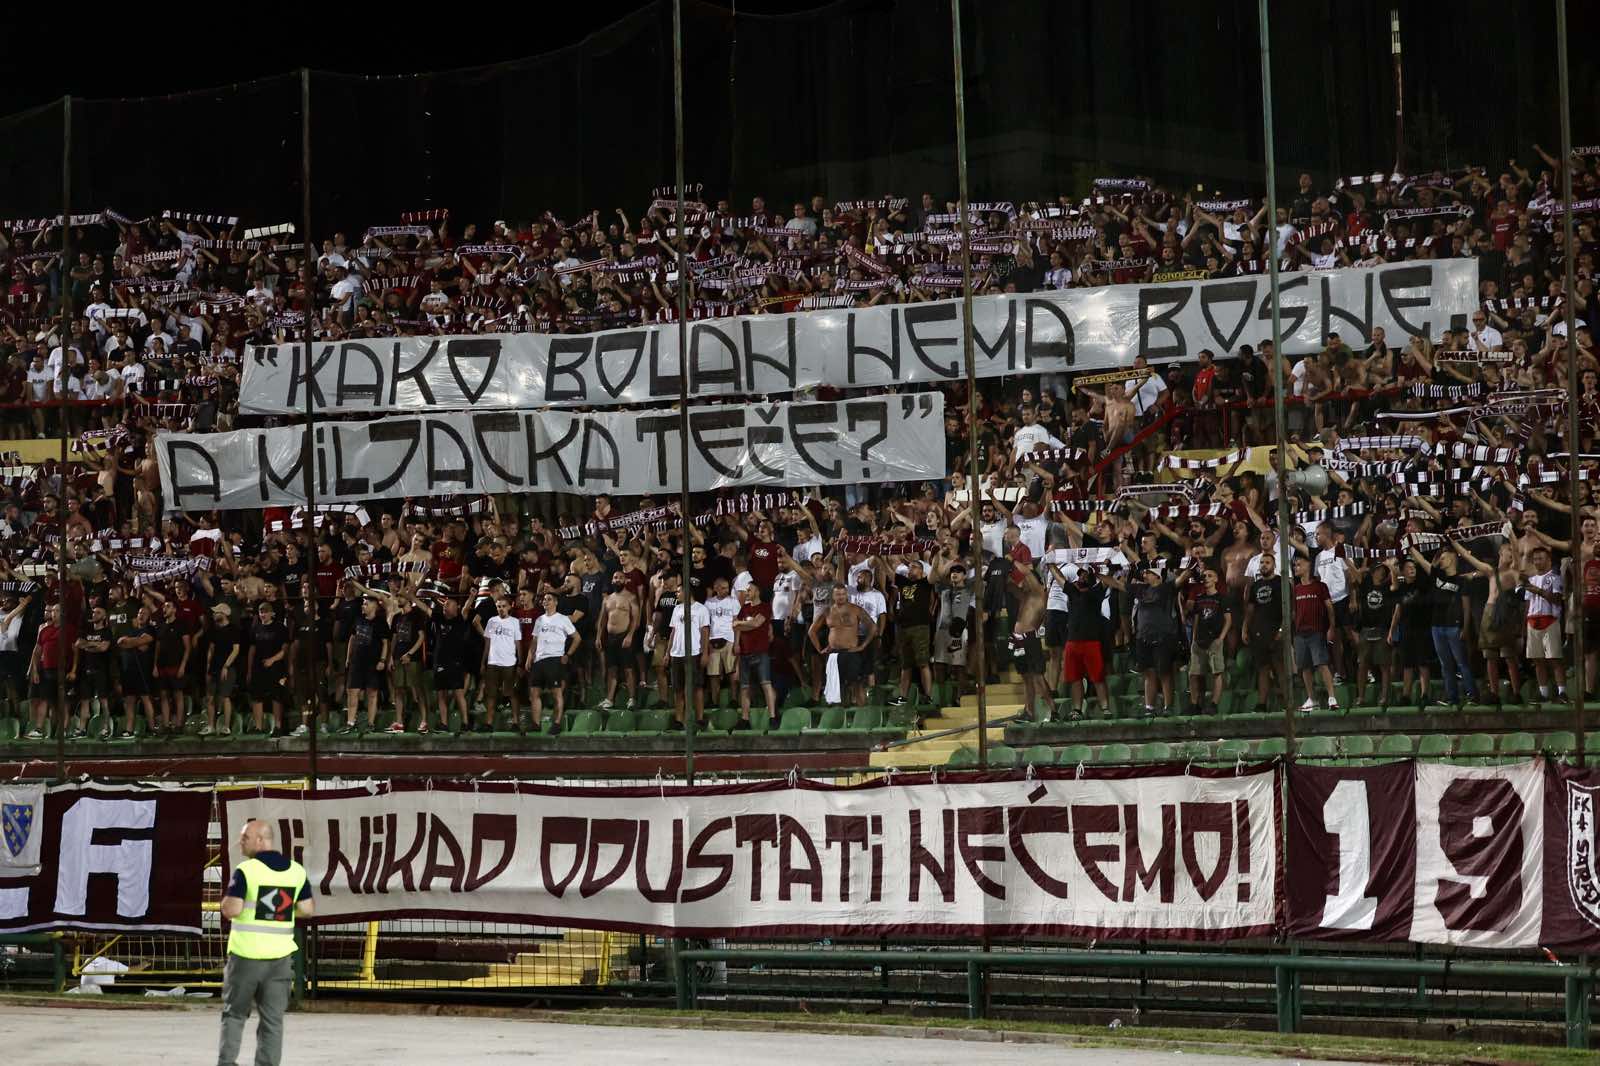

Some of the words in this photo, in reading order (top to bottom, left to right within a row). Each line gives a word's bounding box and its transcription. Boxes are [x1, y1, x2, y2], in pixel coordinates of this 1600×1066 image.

[254, 340, 502, 408] "KAKO
[545, 317, 796, 401] BOLAN
[849, 299, 1075, 385] NEMA
[167, 440, 221, 507] A
[909, 784, 1251, 904] NEĆEMO!
[1574, 796, 1591, 813] FK
